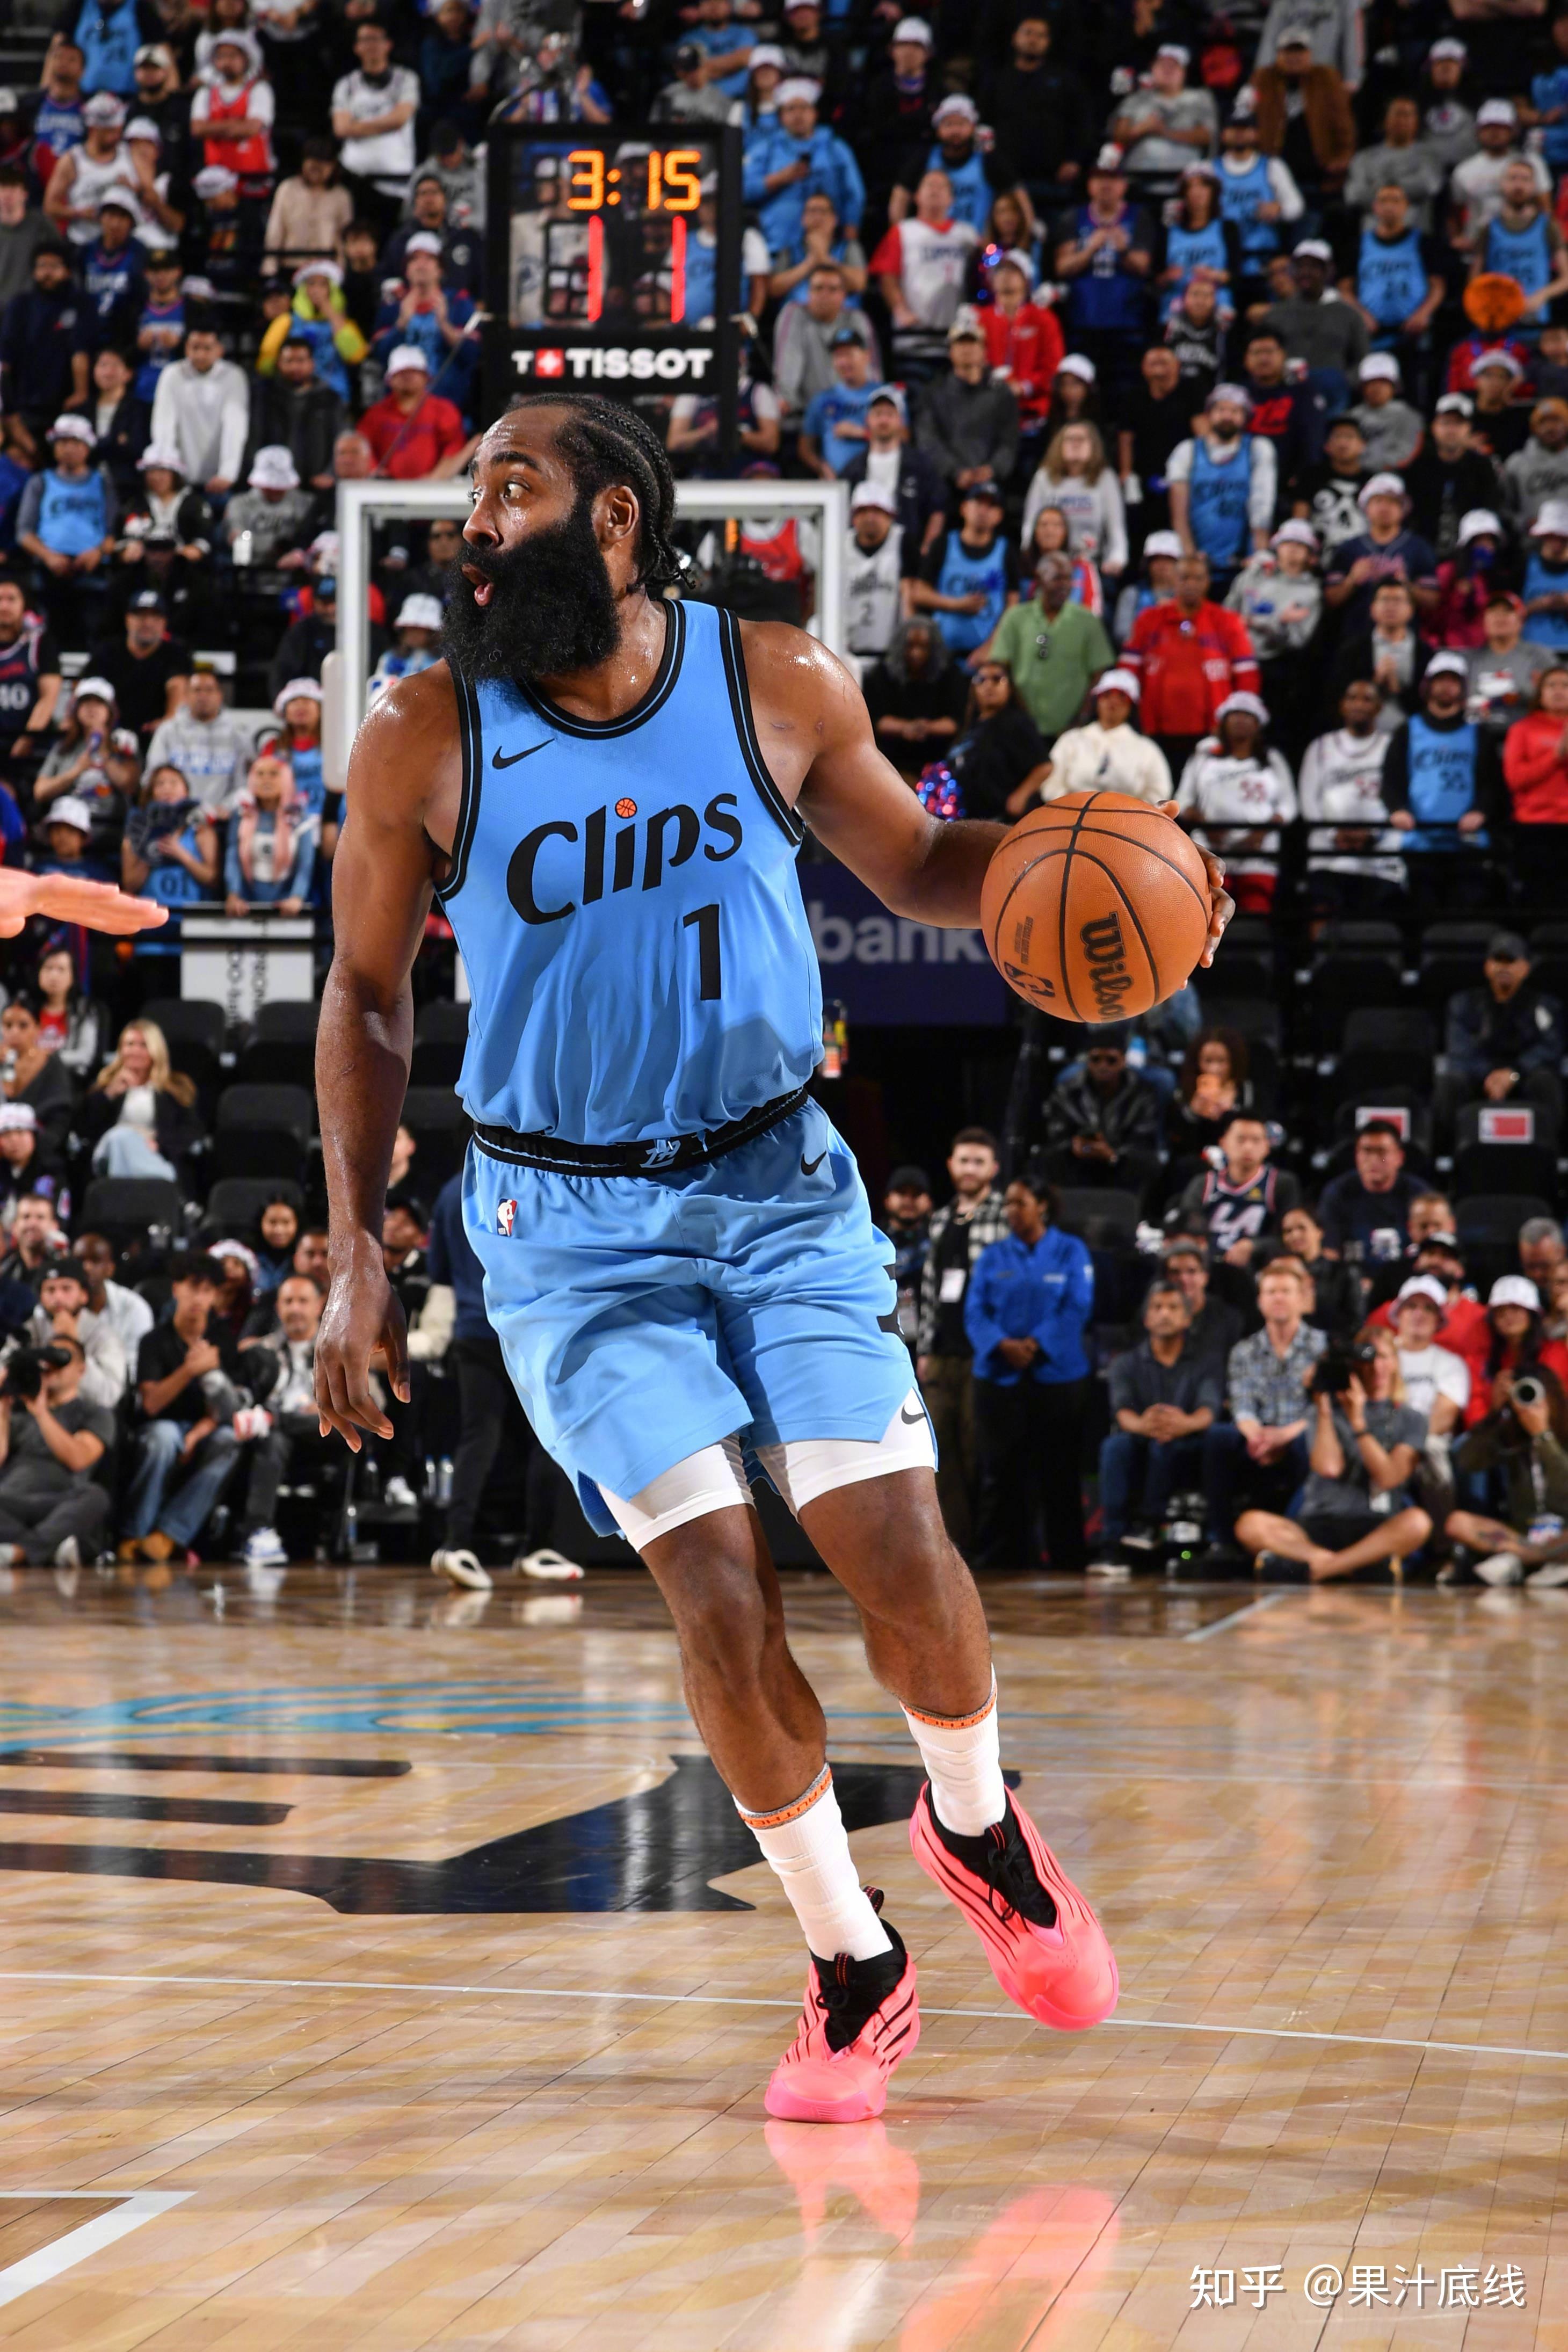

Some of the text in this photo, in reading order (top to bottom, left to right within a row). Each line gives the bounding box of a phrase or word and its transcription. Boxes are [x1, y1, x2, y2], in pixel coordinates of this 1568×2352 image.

[567, 150, 701, 210] 3:15
[565, 349, 713, 379] TISSOT
[506, 793, 743, 925] Clips
[683, 904, 722, 1001] 1
[808, 902, 988, 963] bank
